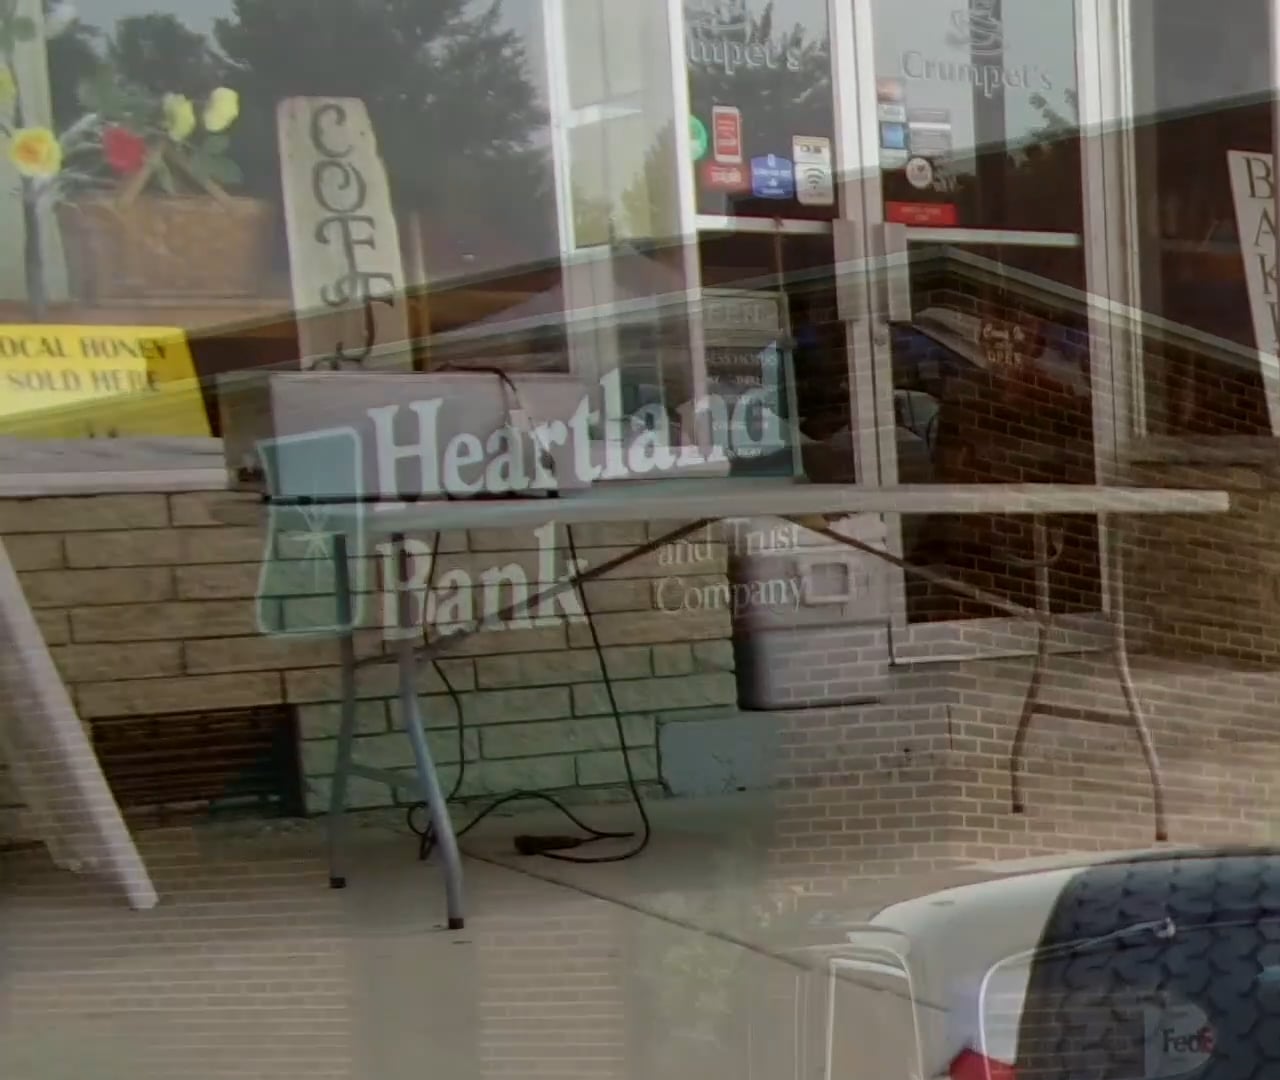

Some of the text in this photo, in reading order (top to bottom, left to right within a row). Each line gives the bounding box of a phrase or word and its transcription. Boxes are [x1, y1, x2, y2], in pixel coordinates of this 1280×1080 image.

[902, 49, 1054, 98] Crumpet's
[0, 335, 168, 360] OCAL HONEY
[7, 369, 160, 392] SOLD HERE
[366, 333, 786, 512] Heartland
[656, 516, 800, 567] and Trust
[375, 520, 590, 643] Bank
[654, 575, 803, 615] Company
